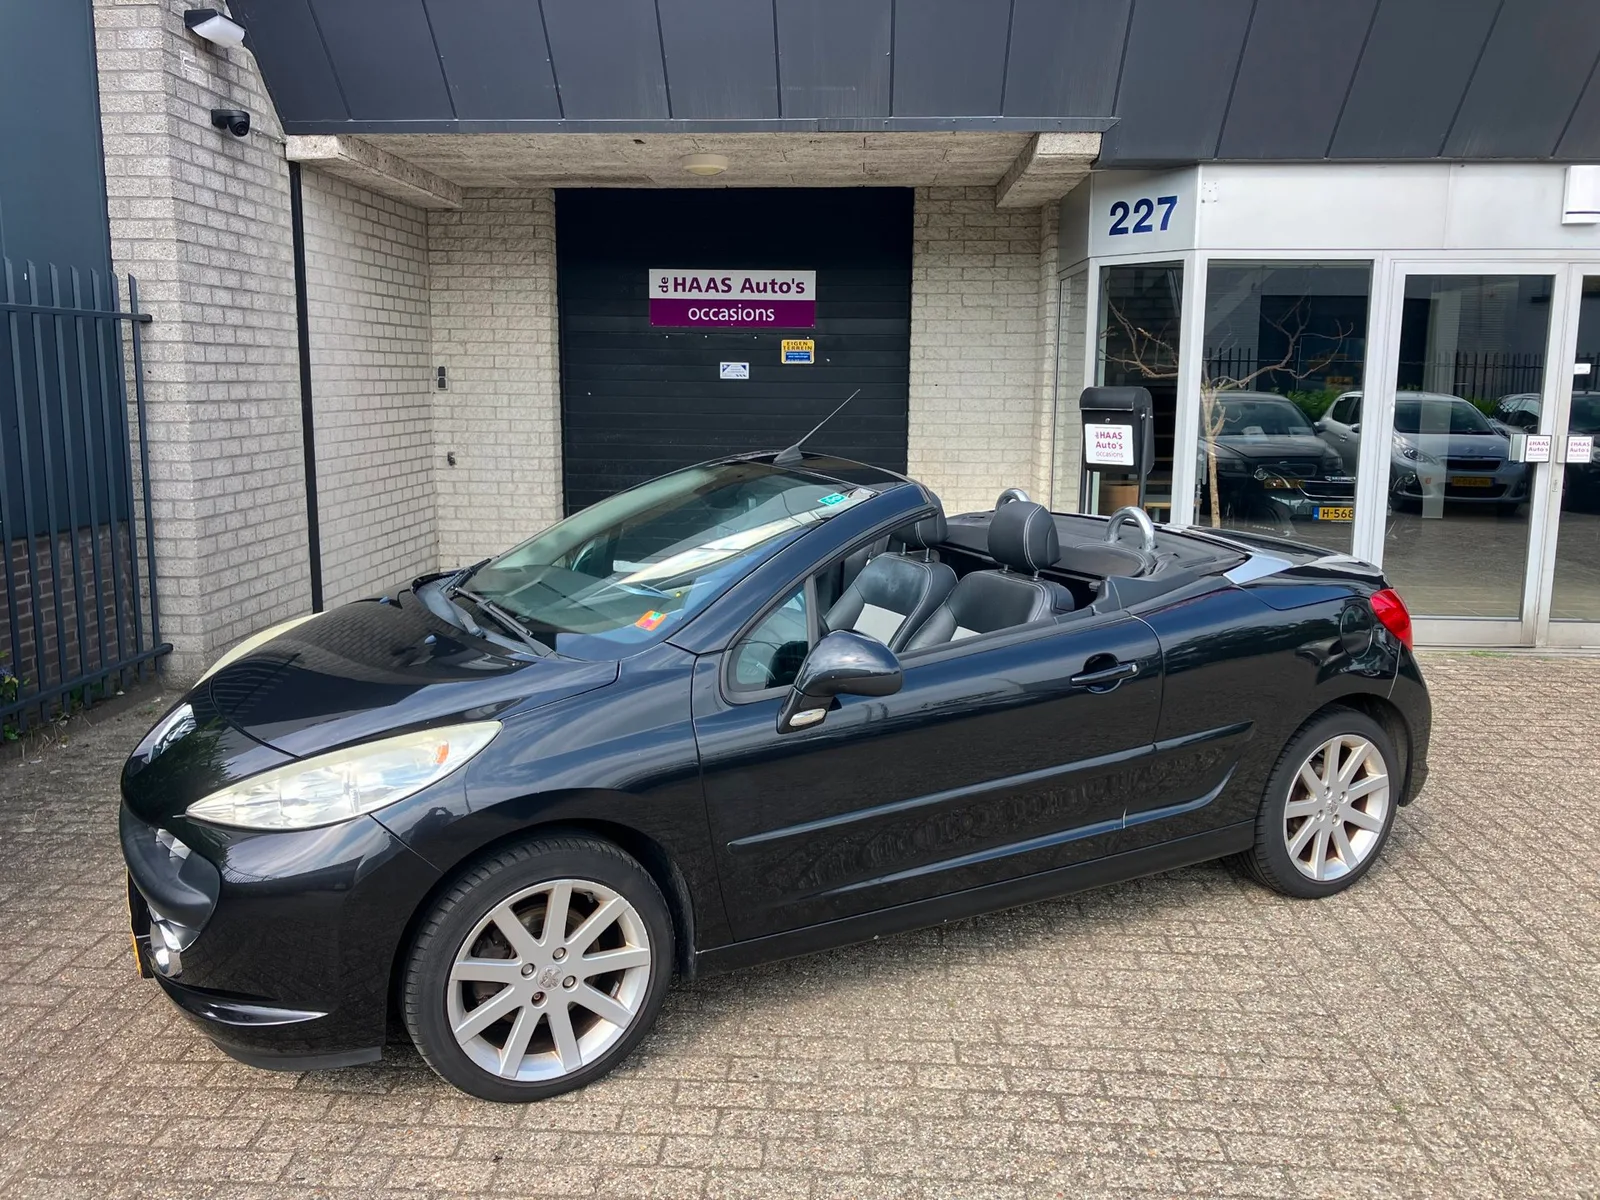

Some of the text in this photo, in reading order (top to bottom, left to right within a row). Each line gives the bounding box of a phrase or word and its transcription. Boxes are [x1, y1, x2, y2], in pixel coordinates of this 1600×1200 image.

[1109, 195, 1178, 236] 227
[659, 277, 805, 294] de HAAS Auto's
[688, 304, 775, 321] occasions
[1100, 431, 1123, 439] HAAS
[1096, 441, 1123, 449] Auto's
